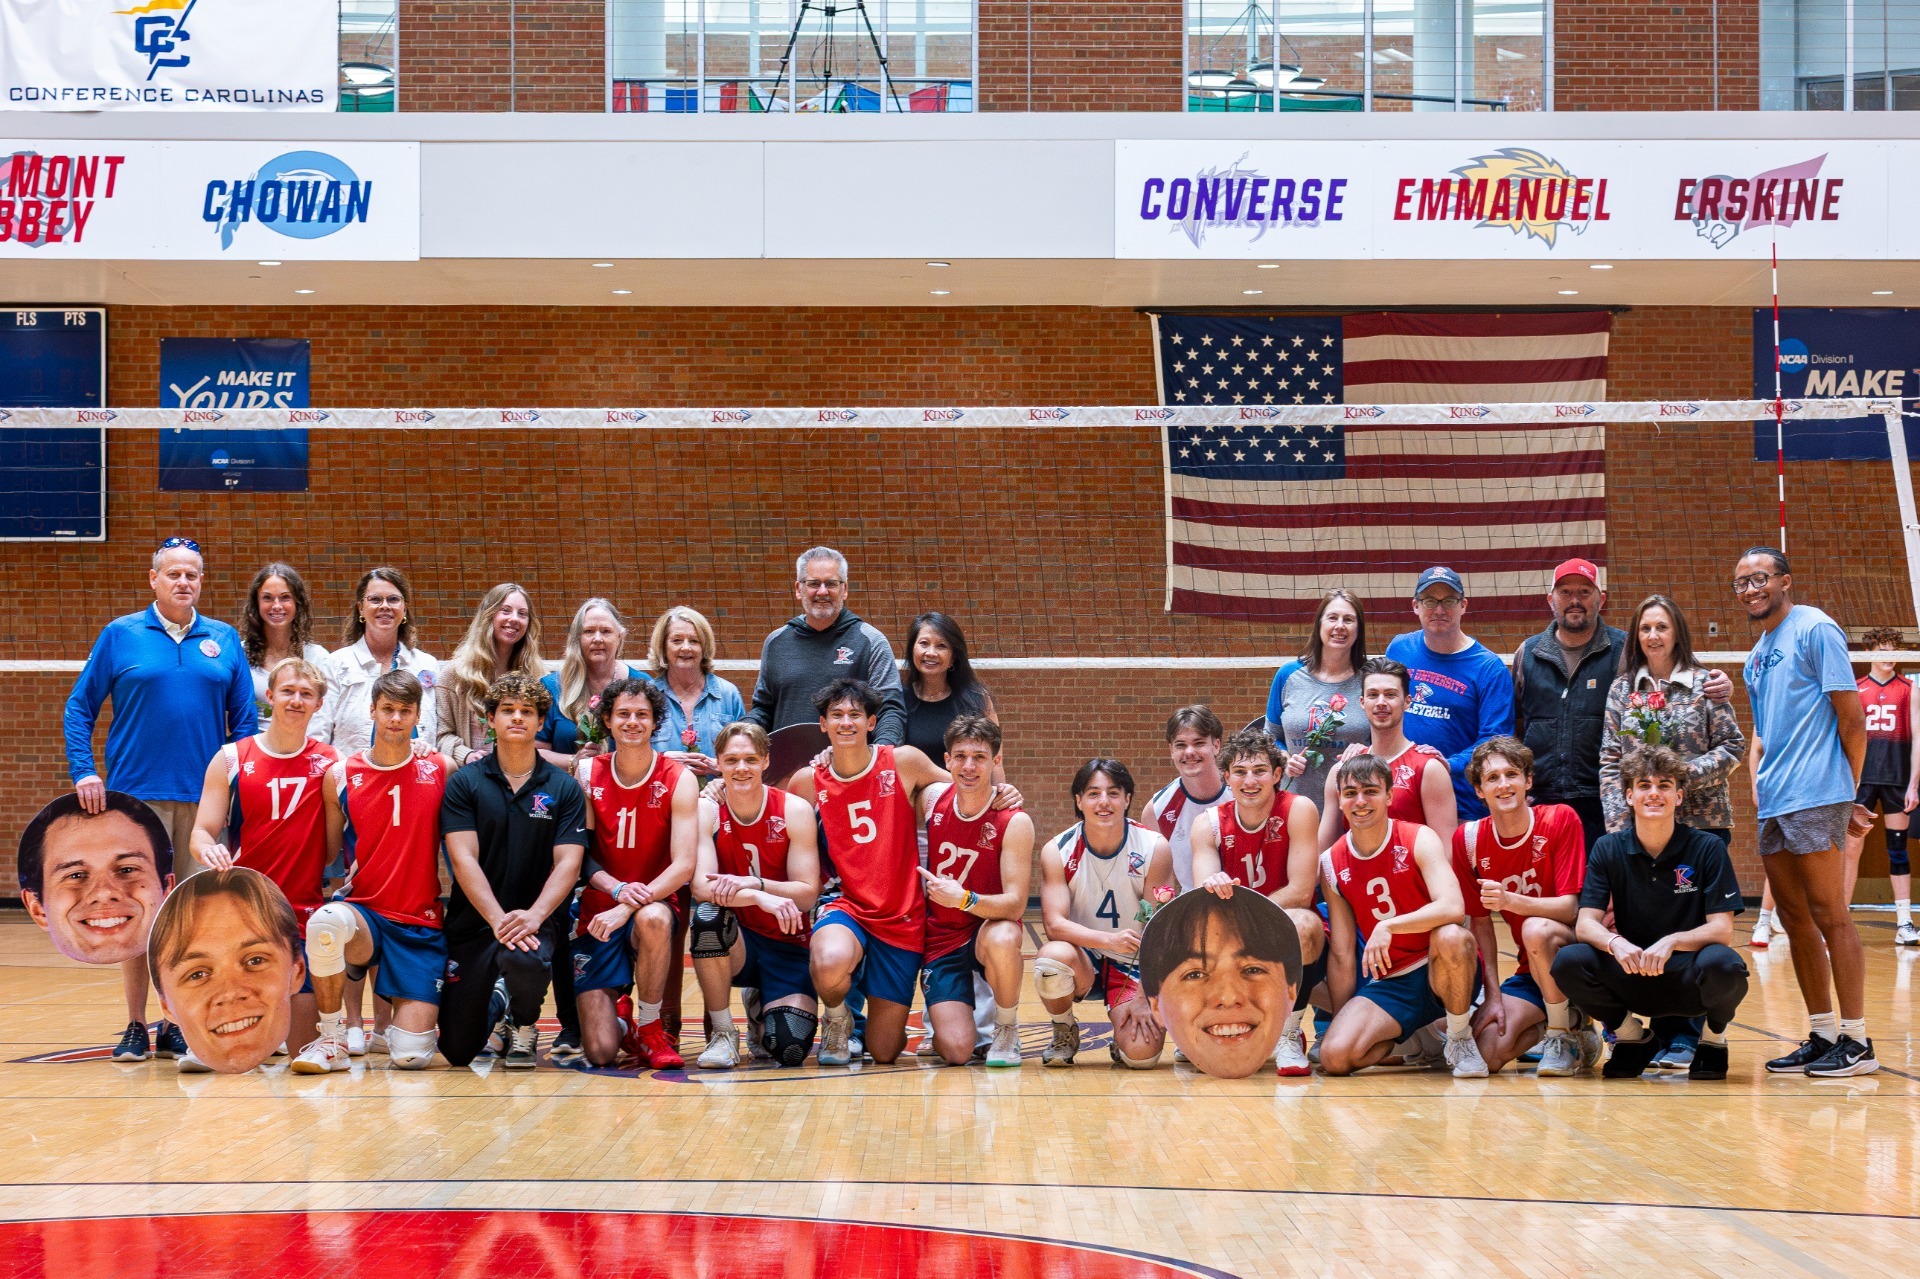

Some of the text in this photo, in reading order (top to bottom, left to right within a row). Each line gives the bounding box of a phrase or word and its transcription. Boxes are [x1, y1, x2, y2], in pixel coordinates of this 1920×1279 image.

[9, 87, 324, 103] CONFERENCE CAROLINAS
[0, 155, 125, 198] MONT
[203, 179, 372, 223] CHOWAN
[1140, 178, 1348, 221] CONVERSE
[1393, 178, 1611, 221] EMMANUEL
[1674, 178, 1844, 221] ERSKINE
[16, 311, 38, 326] FLS
[64, 311, 86, 326] PTS
[1778, 354, 1808, 365] NCAA
[1811, 354, 1847, 364] Division
[216, 371, 297, 387] MAKE IT
[1804, 369, 1906, 396] MAKE
[77, 410, 108, 422] KING
[183, 410, 215, 423] KING
[288, 410, 320, 423] KING
[395, 410, 426, 422] KING
[501, 410, 532, 422] KING
[606, 410, 637, 422] KING
[711, 410, 743, 422] KING
[818, 409, 849, 422] KING
[923, 409, 955, 421] KING
[1029, 408, 1060, 420] KING
[1135, 408, 1166, 420] KING
[1239, 407, 1271, 419] KING
[1344, 406, 1376, 418] KING
[1450, 406, 1482, 418] KING
[1554, 405, 1586, 417] KING
[1660, 404, 1691, 416] KING
[1865, 704, 1897, 731] 25
[266, 777, 308, 820] 17
[388, 785, 401, 827] 1
[616, 807, 637, 849] 11
[847, 800, 877, 844] 5
[936, 841, 979, 886] 27
[1366, 877, 1397, 921] 3
[1095, 889, 1121, 929] 4
